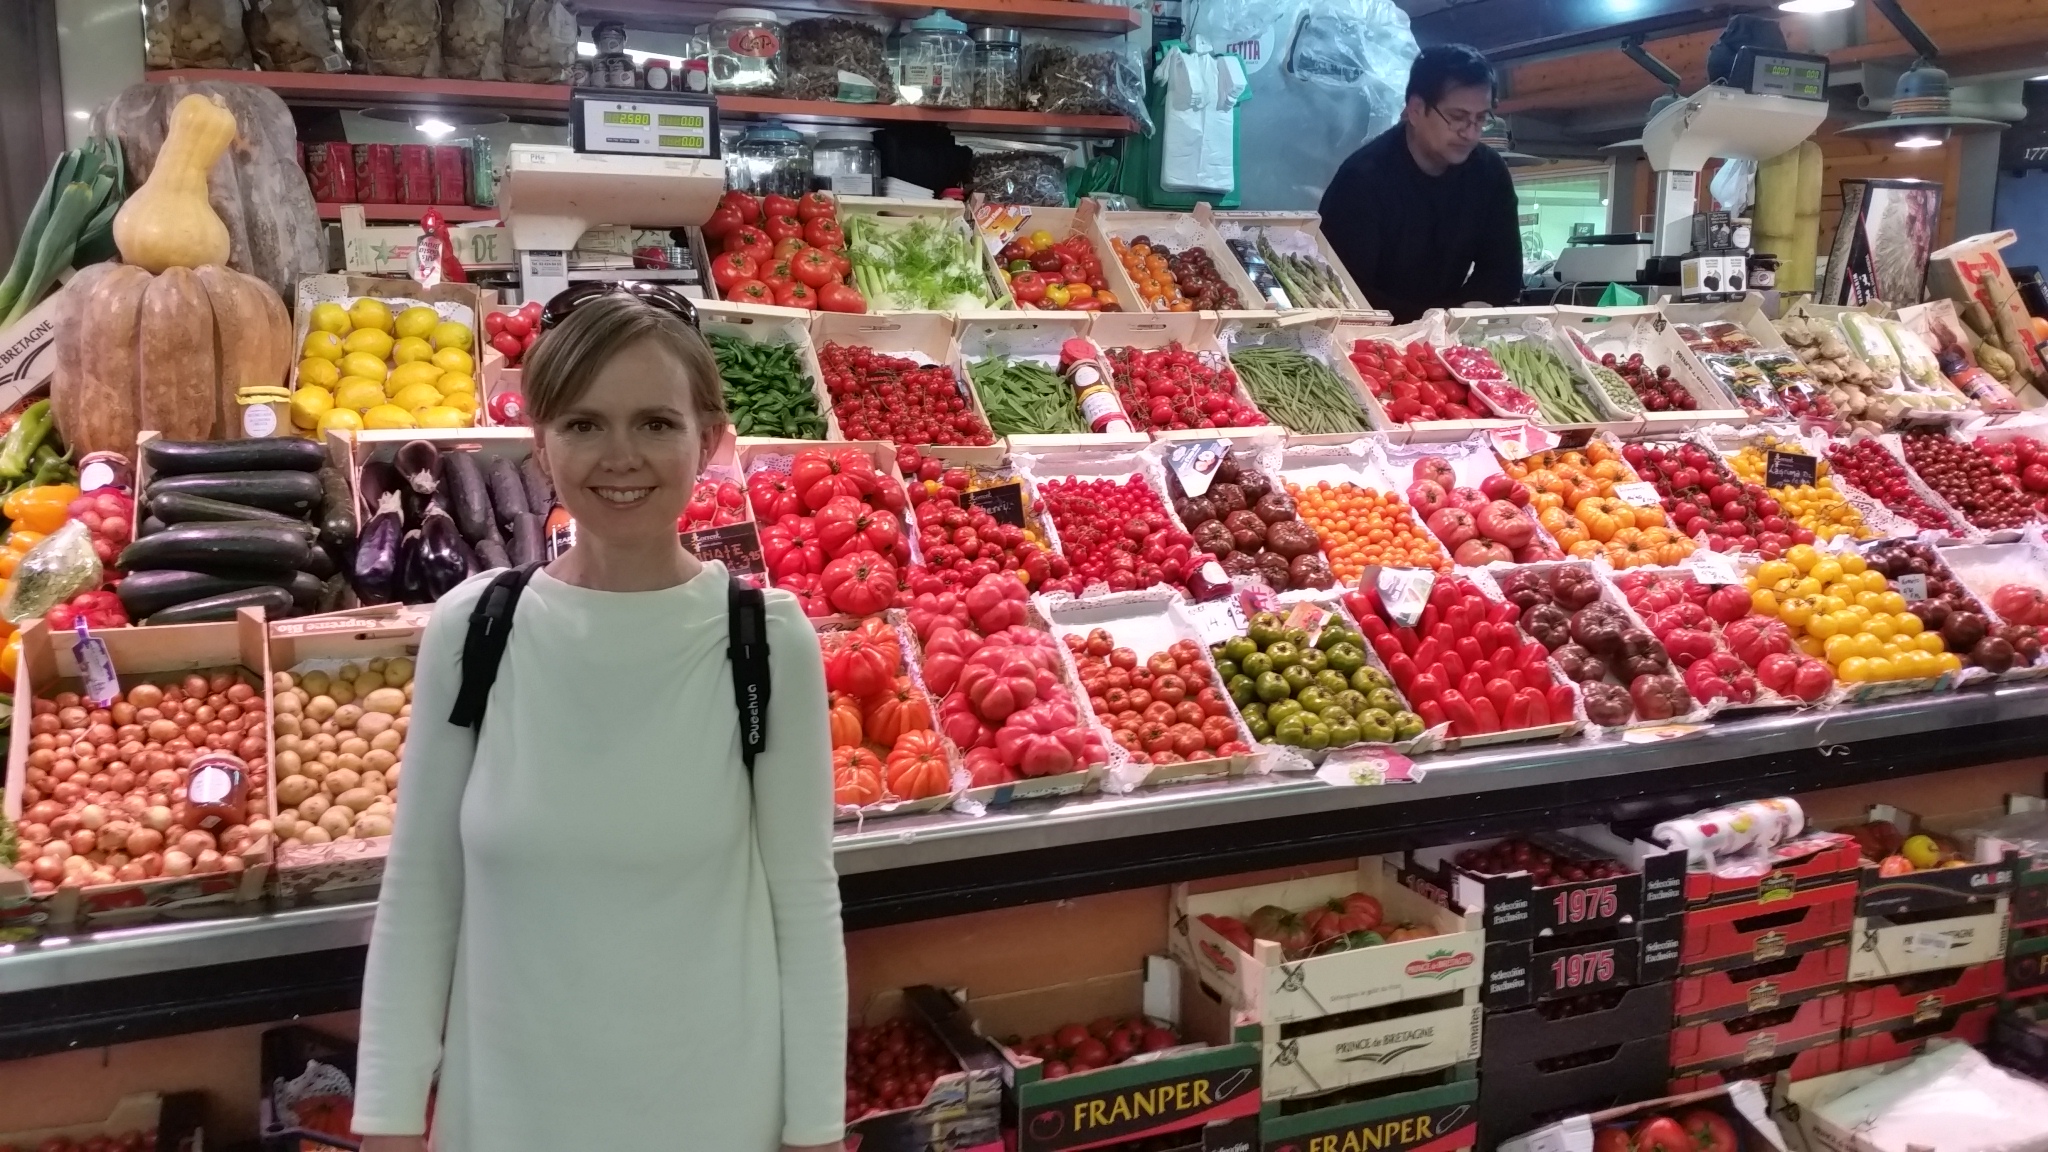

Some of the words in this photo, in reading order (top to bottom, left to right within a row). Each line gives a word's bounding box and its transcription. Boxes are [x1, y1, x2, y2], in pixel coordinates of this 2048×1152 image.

[620, 113, 649, 125] 2.580
[681, 116, 701, 127] 0.00
[681, 136, 701, 147] 0.00
[1, 319, 54, 364] BRETAGNE
[277, 623, 305, 634] Bio
[747, 684, 760, 745] Quechua
[1553, 885, 1617, 925] 1975
[1552, 948, 1615, 990] 1975
[1335, 1038, 1371, 1054] PRINCE
[1382, 1026, 1435, 1046] BRETAGNE
[1467, 1006, 1480, 1058] Tomates
[1073, 1078, 1212, 1132] FRANPER
[1309, 1115, 1434, 1152] FRANPER
